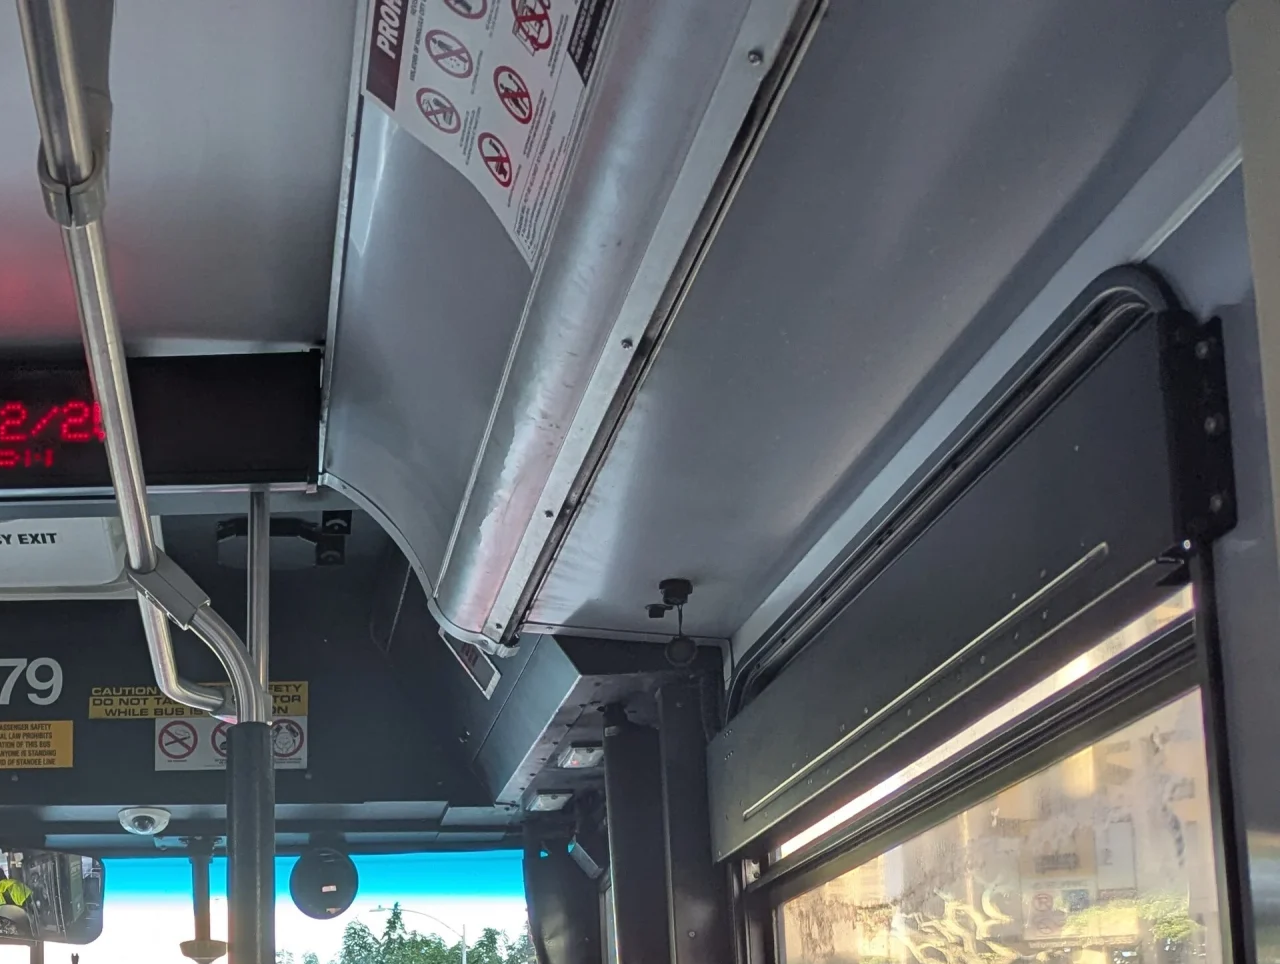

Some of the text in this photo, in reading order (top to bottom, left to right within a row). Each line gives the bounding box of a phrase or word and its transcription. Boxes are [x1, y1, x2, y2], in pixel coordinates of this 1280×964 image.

[19, 533, 57, 544] EXIT
[92, 687, 157, 696] CAUTION
[93, 698, 148, 707] DO NOT
[105, 707, 204, 716] WHILE BUS IS
